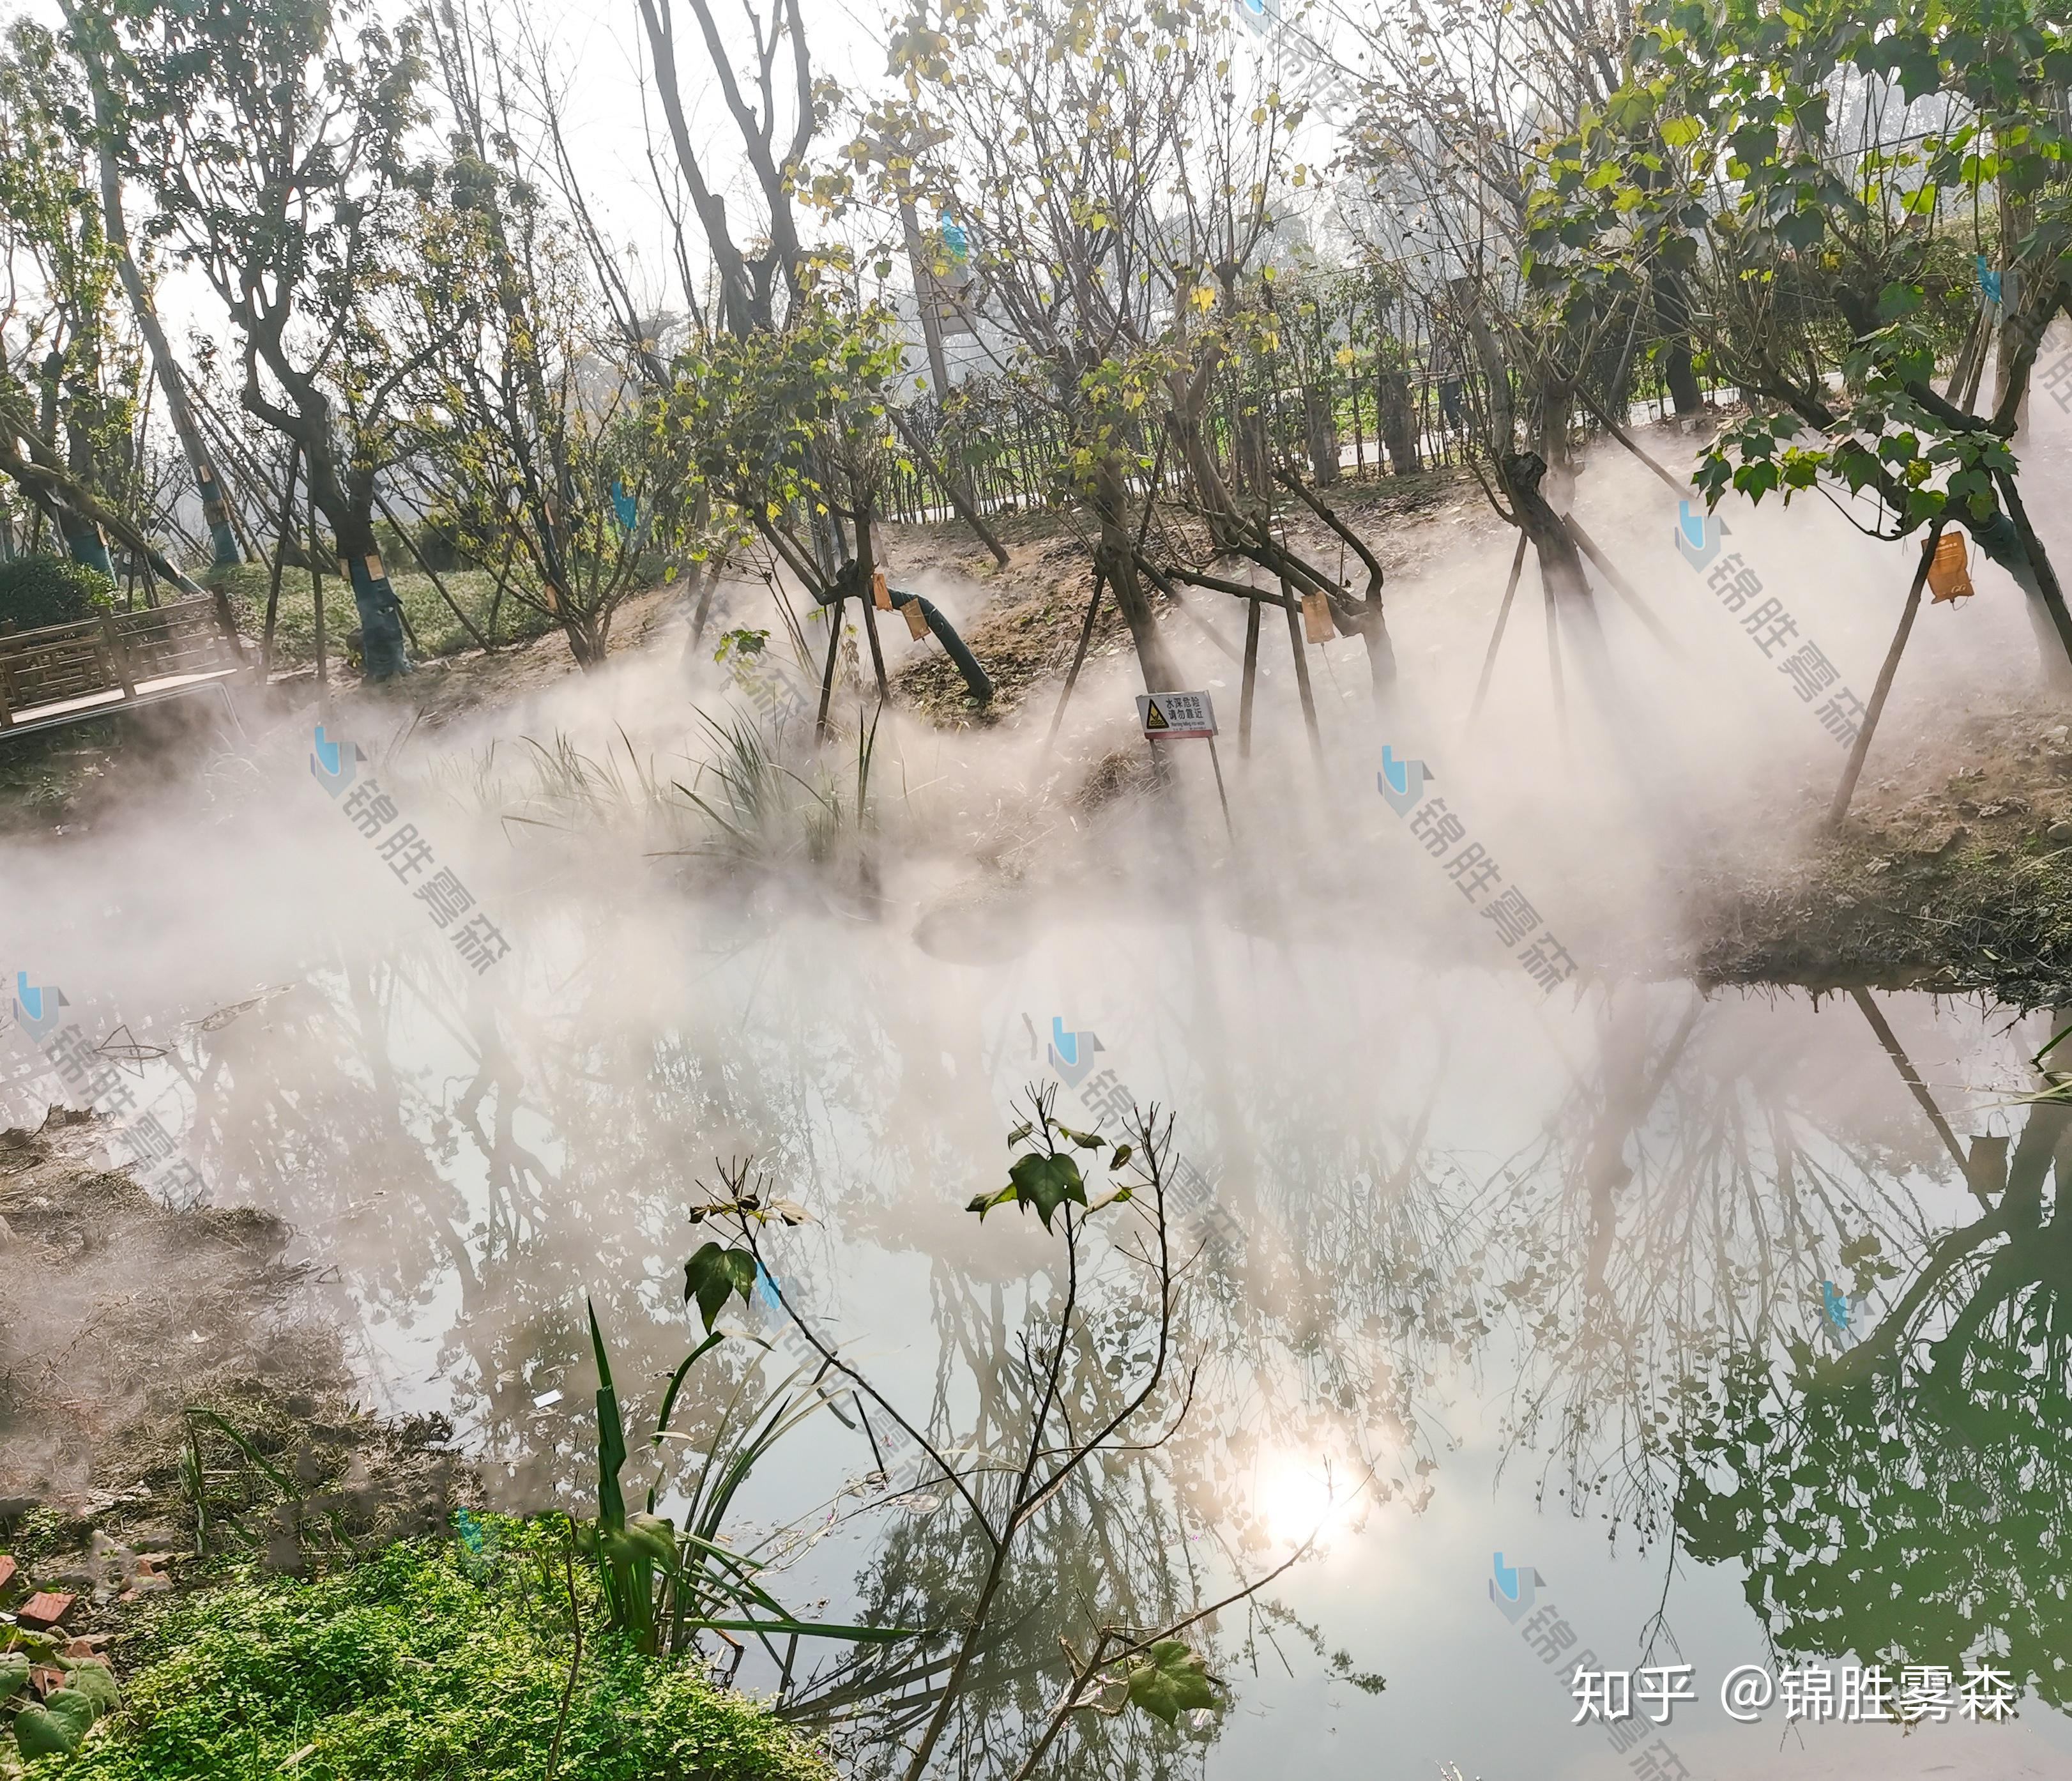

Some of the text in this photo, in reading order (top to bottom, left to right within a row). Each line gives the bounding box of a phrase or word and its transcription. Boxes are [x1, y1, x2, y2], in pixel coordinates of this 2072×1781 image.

[1166, 696, 1200, 708] 水深危险
[1168, 708, 1203, 720] 请勿靠近
